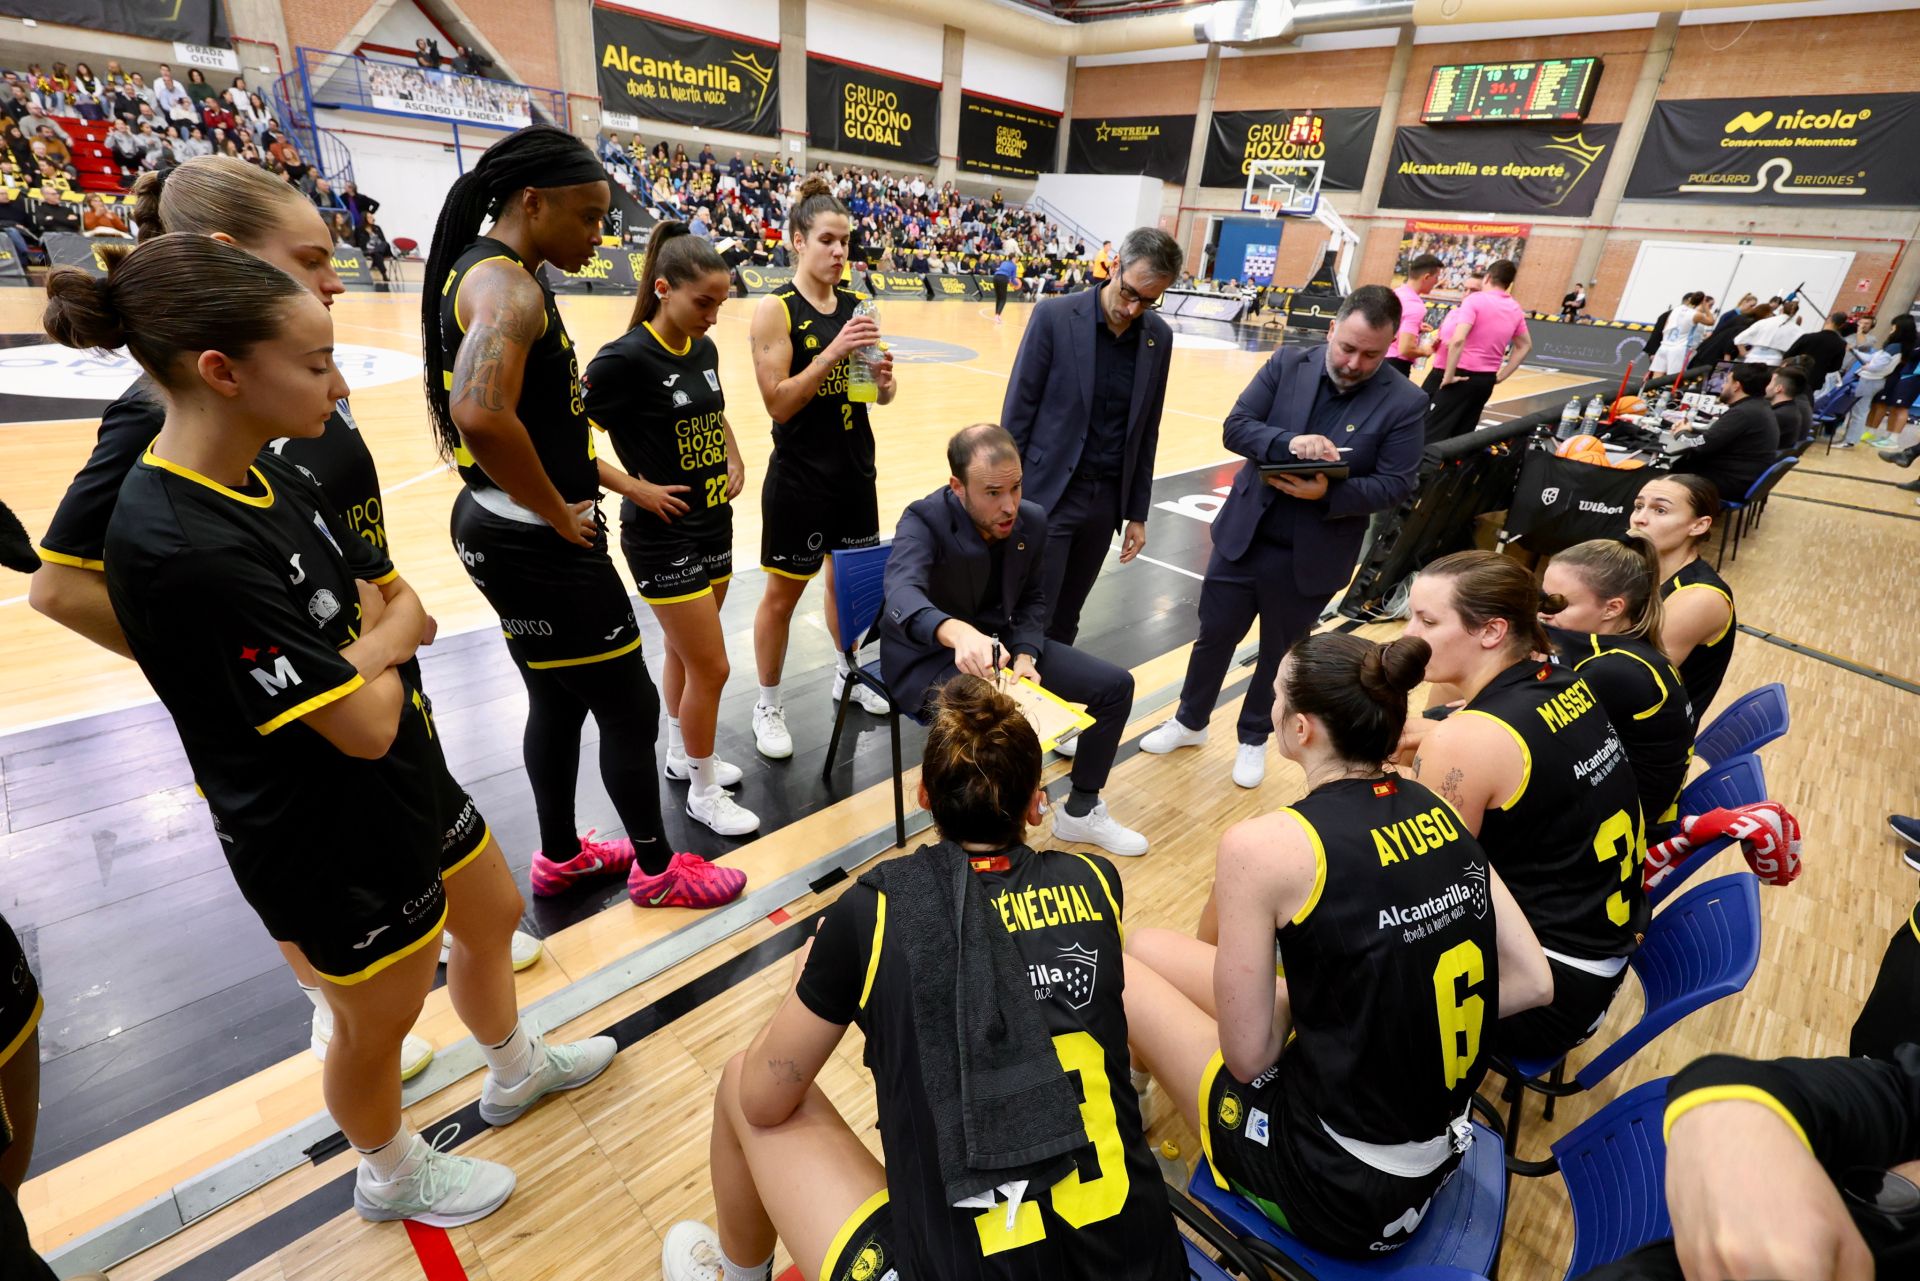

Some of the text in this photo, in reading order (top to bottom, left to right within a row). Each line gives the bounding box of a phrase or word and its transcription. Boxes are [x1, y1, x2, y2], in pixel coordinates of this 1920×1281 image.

[191, 55, 224, 66] OESTE
[602, 44, 741, 93] Alcantarilla
[1487, 70, 1502, 81] 19
[626, 78, 726, 105] donde la huerta nace
[844, 82, 898, 111] GRUPO
[405, 102, 504, 122] ASCENSO LF ENDESA
[844, 104, 912, 131] HOZONO
[844, 120, 902, 146] GLOBAL
[996, 126, 1021, 139] GRUPO
[996, 136, 1027, 150] HOZONO
[1111, 126, 1160, 136] ESTRELLA
[1290, 125, 1310, 140] 24
[1720, 138, 1858, 148] Conservando Momentos
[996, 145, 1022, 158] GLOBAL
[1244, 141, 1326, 159] HOZONO
[1398, 162, 1565, 179] Alcantarilla es deporte
[1688, 174, 1854, 185] POLICARPO BRIONES
[842, 403, 853, 431] 2
[677, 429, 726, 455] HOZO
[680, 445, 728, 470] GLOBA
[705, 473, 728, 508] 22
[1579, 500, 1624, 514] Wilson
[701, 550, 732, 563] Alcant
[654, 573, 680, 582] Costa
[250, 655, 303, 697] M
[1536, 678, 1596, 734] MASSEY
[1573, 737, 1619, 780] Alcantarilla
[1370, 806, 1459, 867] AYUSO
[403, 882, 438, 915] Costa
[991, 884, 1103, 933] ÉNÉCHAL
[1378, 883, 1472, 930] Alcantarilla
[1403, 905, 1466, 944] donde la huerta nace
[1034, 987, 1052, 1000] ace
[1433, 939, 1484, 1090] 6
